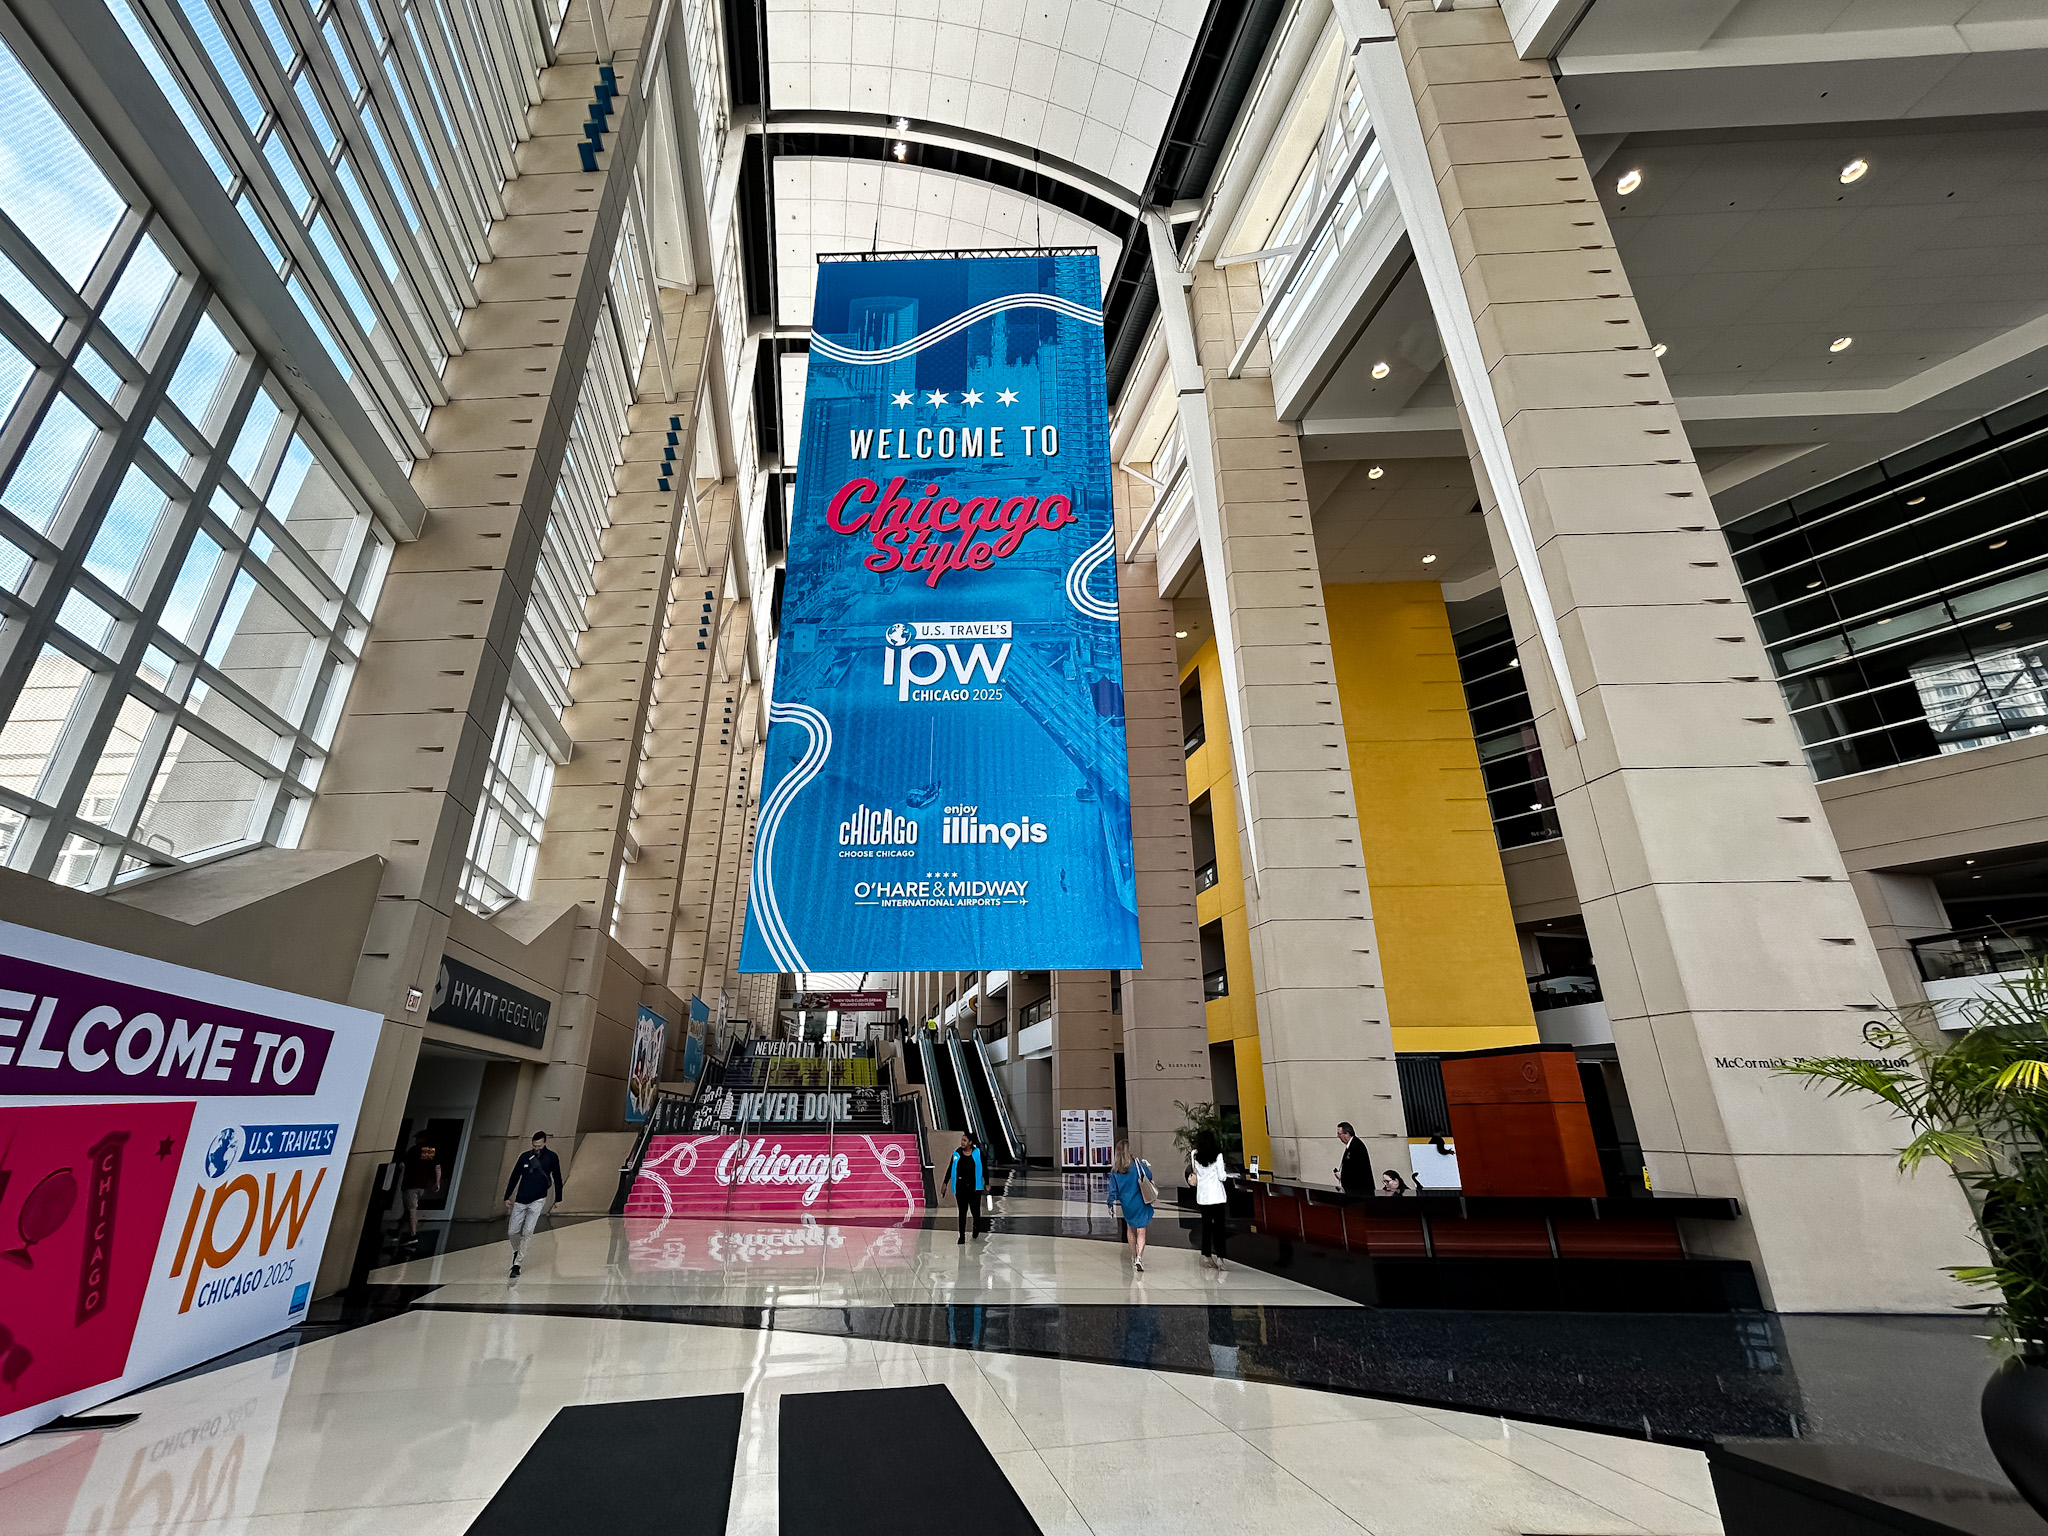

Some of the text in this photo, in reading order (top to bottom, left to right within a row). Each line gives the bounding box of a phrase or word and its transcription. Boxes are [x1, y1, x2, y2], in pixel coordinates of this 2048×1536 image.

[850, 426, 1059, 460] WELCOME TO
[826, 476, 1077, 558] Chicago
[863, 526, 995, 588] Style
[921, 623, 1008, 636] U.S. TRAVEL'S
[883, 641, 1012, 702] ipw
[912, 688, 1003, 701] CHICAGO 2025
[838, 803, 918, 846] CHICAGO
[944, 803, 978, 816] enjoy
[942, 816, 1048, 850] illinois
[838, 850, 874, 858] CHOOSE
[854, 880, 1029, 898] O'HARE & MIDWAY
[881, 898, 1001, 907] INTERNATIONAL AIRPORTS
[451, 980, 548, 1032] HYATT REGENCY
[250, 1031, 305, 1085] TO
[755, 1041, 785, 1056] NEVER
[1715, 1057, 1787, 1069] McCormick
[736, 1092, 799, 1122] NEVER
[802, 1092, 853, 1122] DONE
[248, 1129, 334, 1155] U.S. TRAVEL'S
[714, 1138, 851, 1206] Chicago
[85, 1154, 113, 1310] CHICAGO
[169, 1167, 327, 1315] ipw
[197, 1258, 296, 1308] CHICAGO 2025
